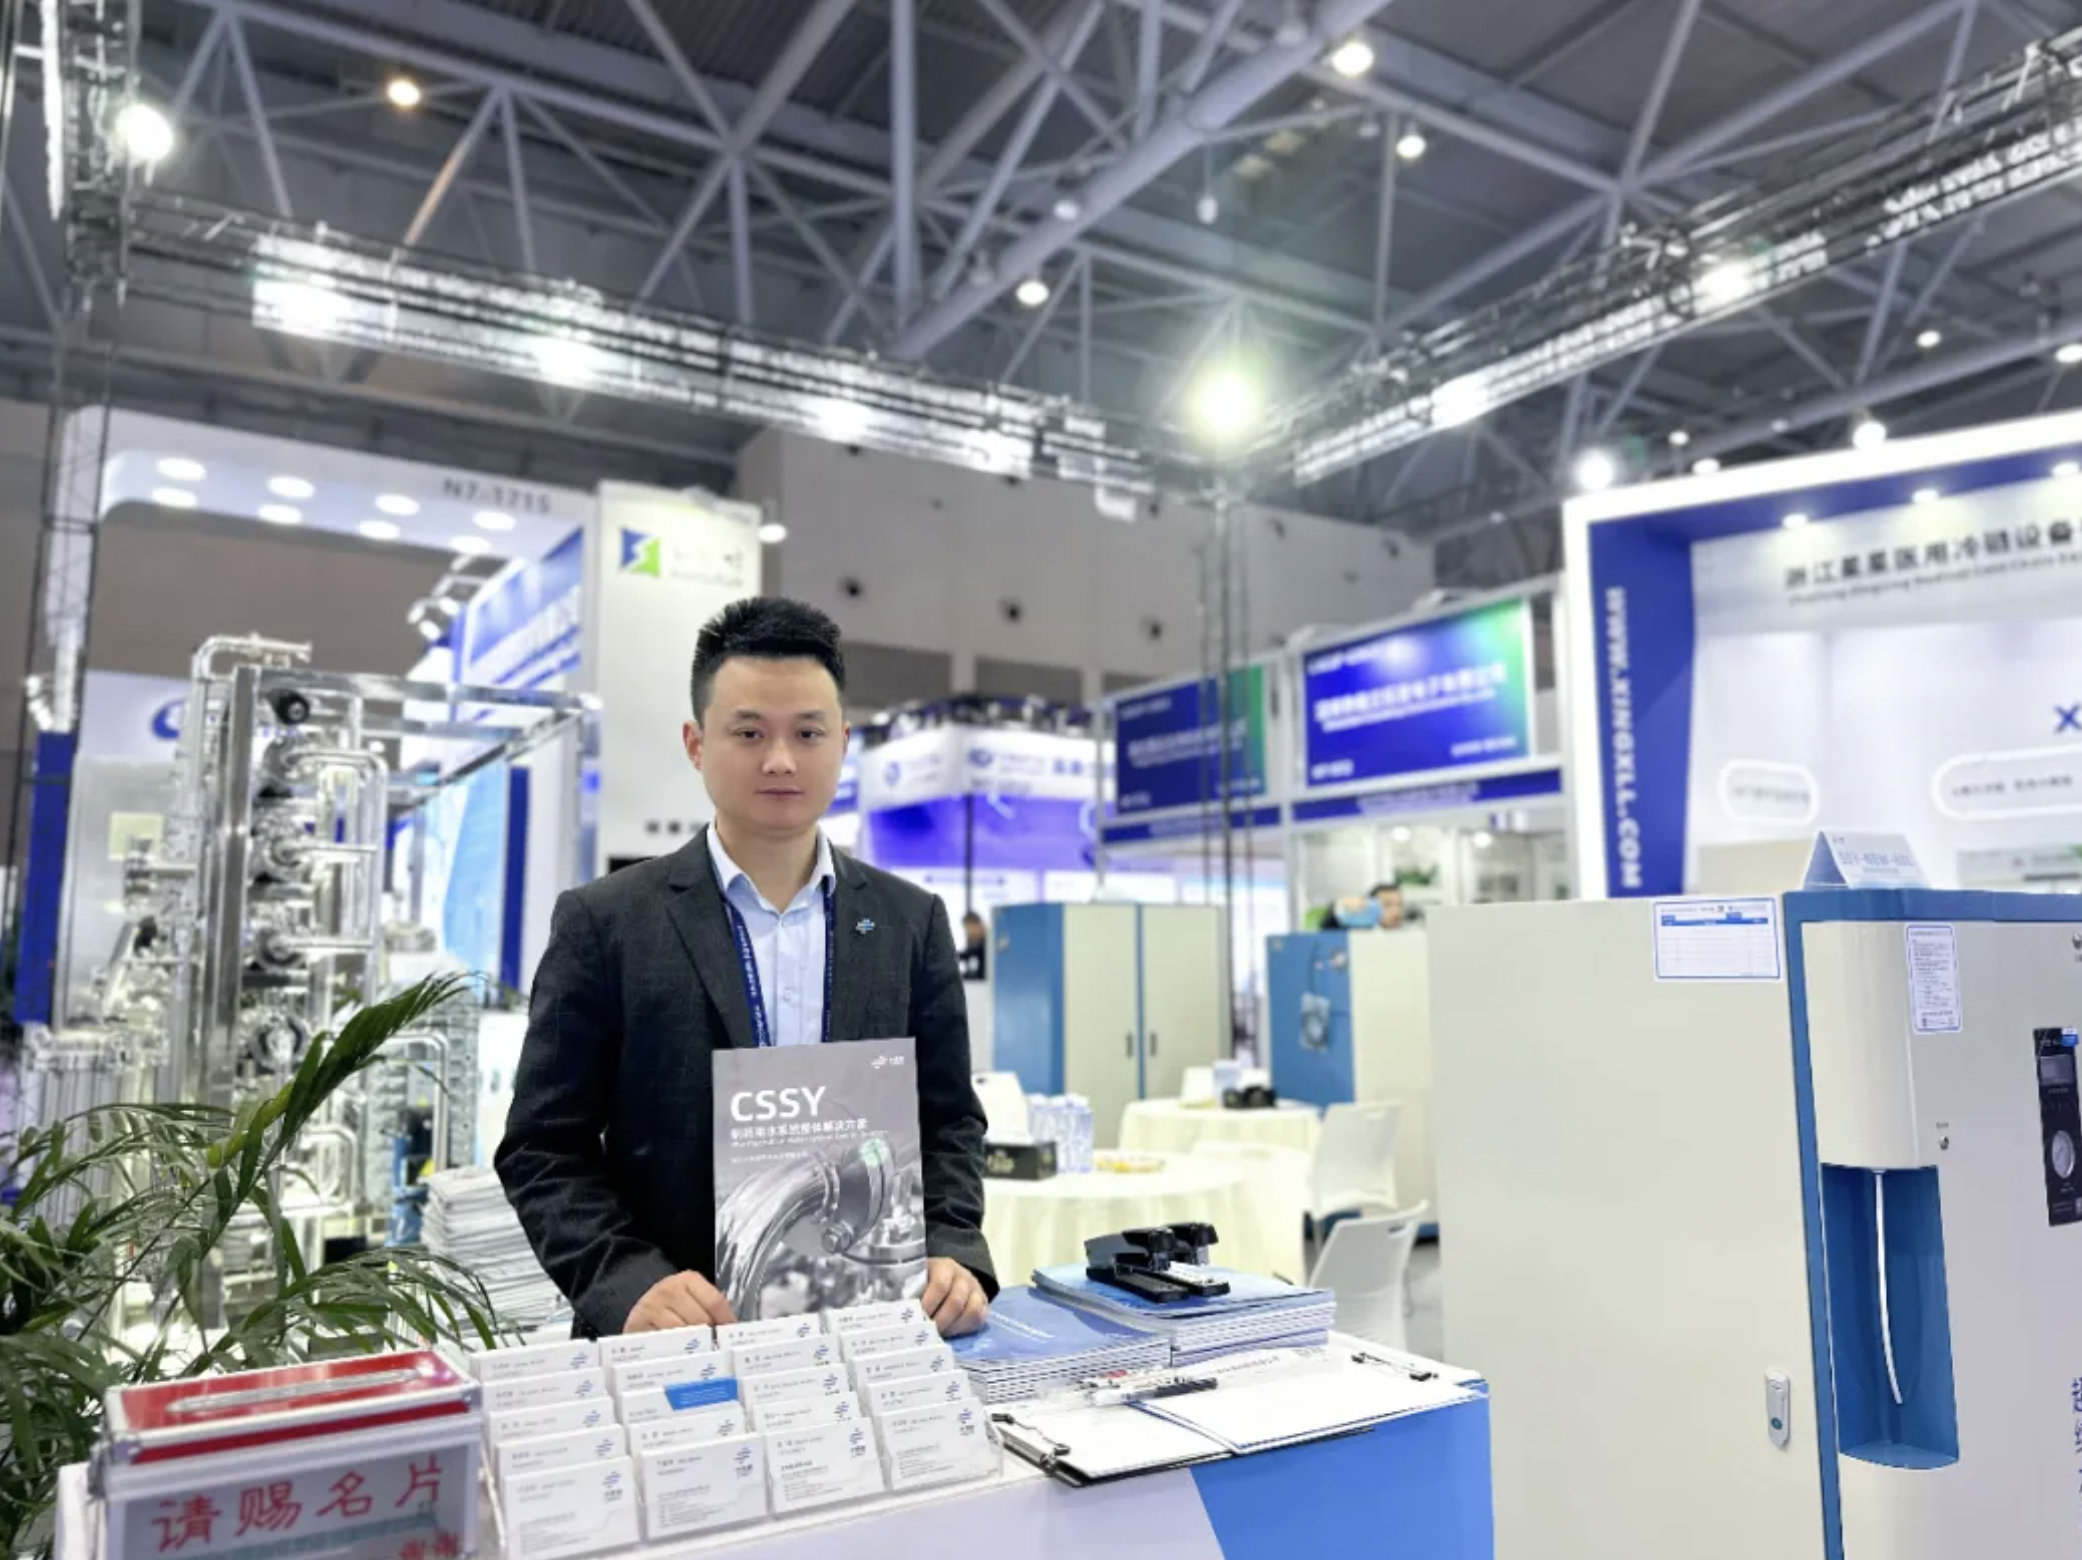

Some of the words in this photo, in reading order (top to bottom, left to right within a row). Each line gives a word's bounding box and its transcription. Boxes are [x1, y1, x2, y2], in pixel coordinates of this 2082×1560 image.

[1785, 520, 2082, 589] 浙江星星医用冷链设备
[1606, 587, 1642, 888] WWW.XINGXLL.COM
[730, 1085, 827, 1122] CSSY
[151, 1453, 442, 1553] 请赐名片
